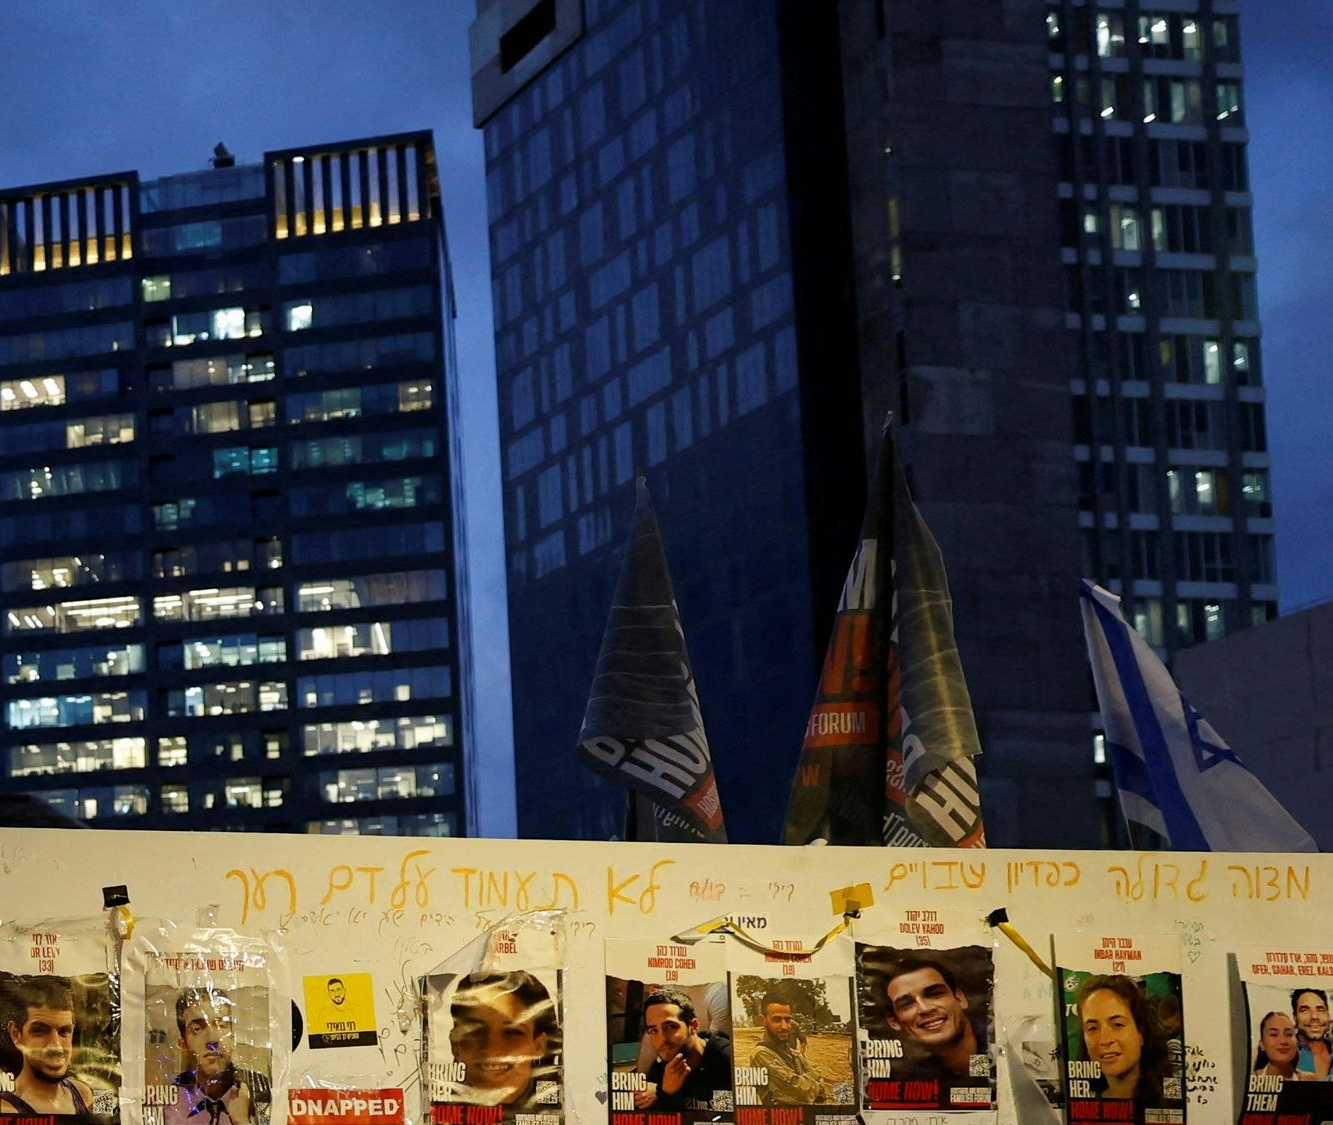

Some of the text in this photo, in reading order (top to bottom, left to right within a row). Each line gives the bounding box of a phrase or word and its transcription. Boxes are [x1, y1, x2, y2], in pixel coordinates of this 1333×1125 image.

[810, 712, 865, 736] FORUM
[226, 869, 296, 923] רעך
[321, 865, 383, 904] דם
[390, 850, 436, 908] על
[451, 867, 579, 910] תעמוד
[607, 859, 676, 915] לא
[884, 860, 1310, 902] מצוה גדולה כפדיון שבויים
[1115, 950, 1141, 960] HAYMAN
[1068, 1061, 1101, 1078] BRING
[1070, 1080, 1090, 1098] HER
